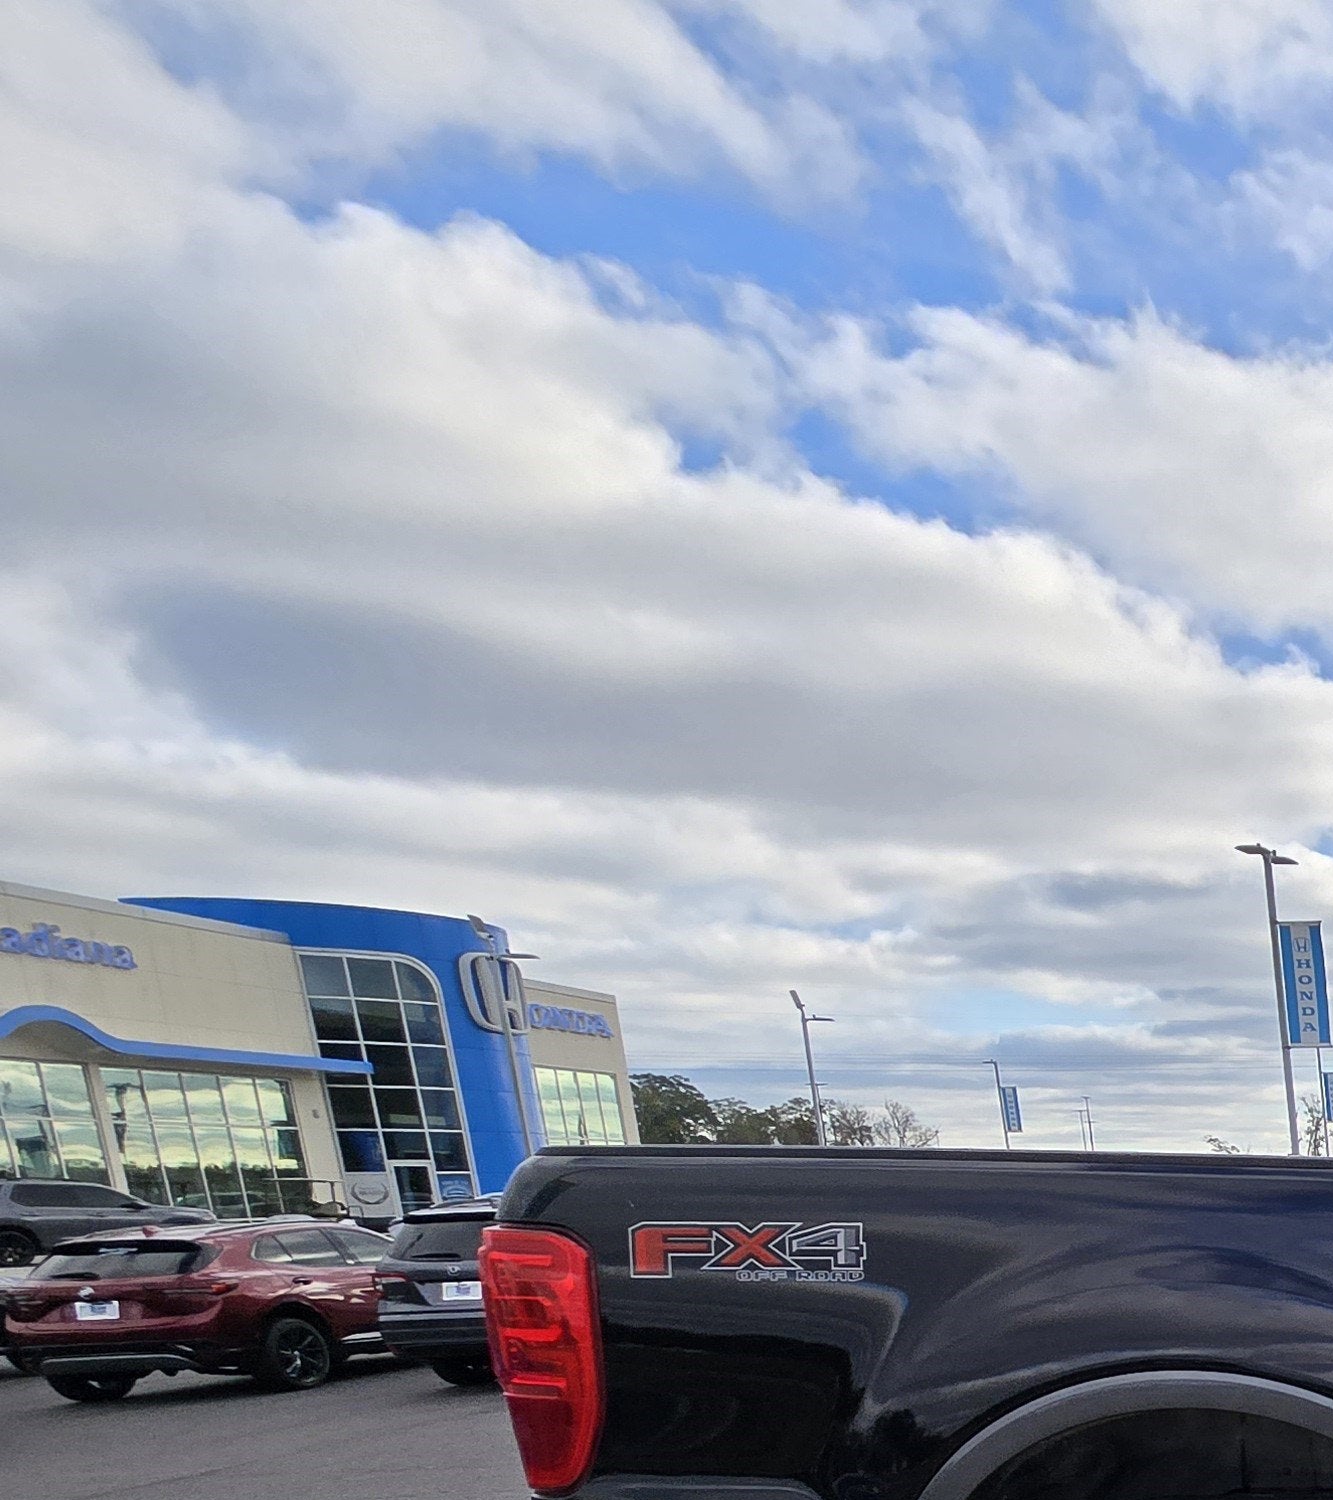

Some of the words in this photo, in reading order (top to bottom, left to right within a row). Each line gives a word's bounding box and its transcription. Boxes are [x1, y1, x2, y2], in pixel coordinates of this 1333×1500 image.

[1295, 958, 1317, 1032] HONDA
[628, 1221, 867, 1279] FX4
[736, 1270, 789, 1282] OFF
[795, 1270, 865, 1282] ROAD
